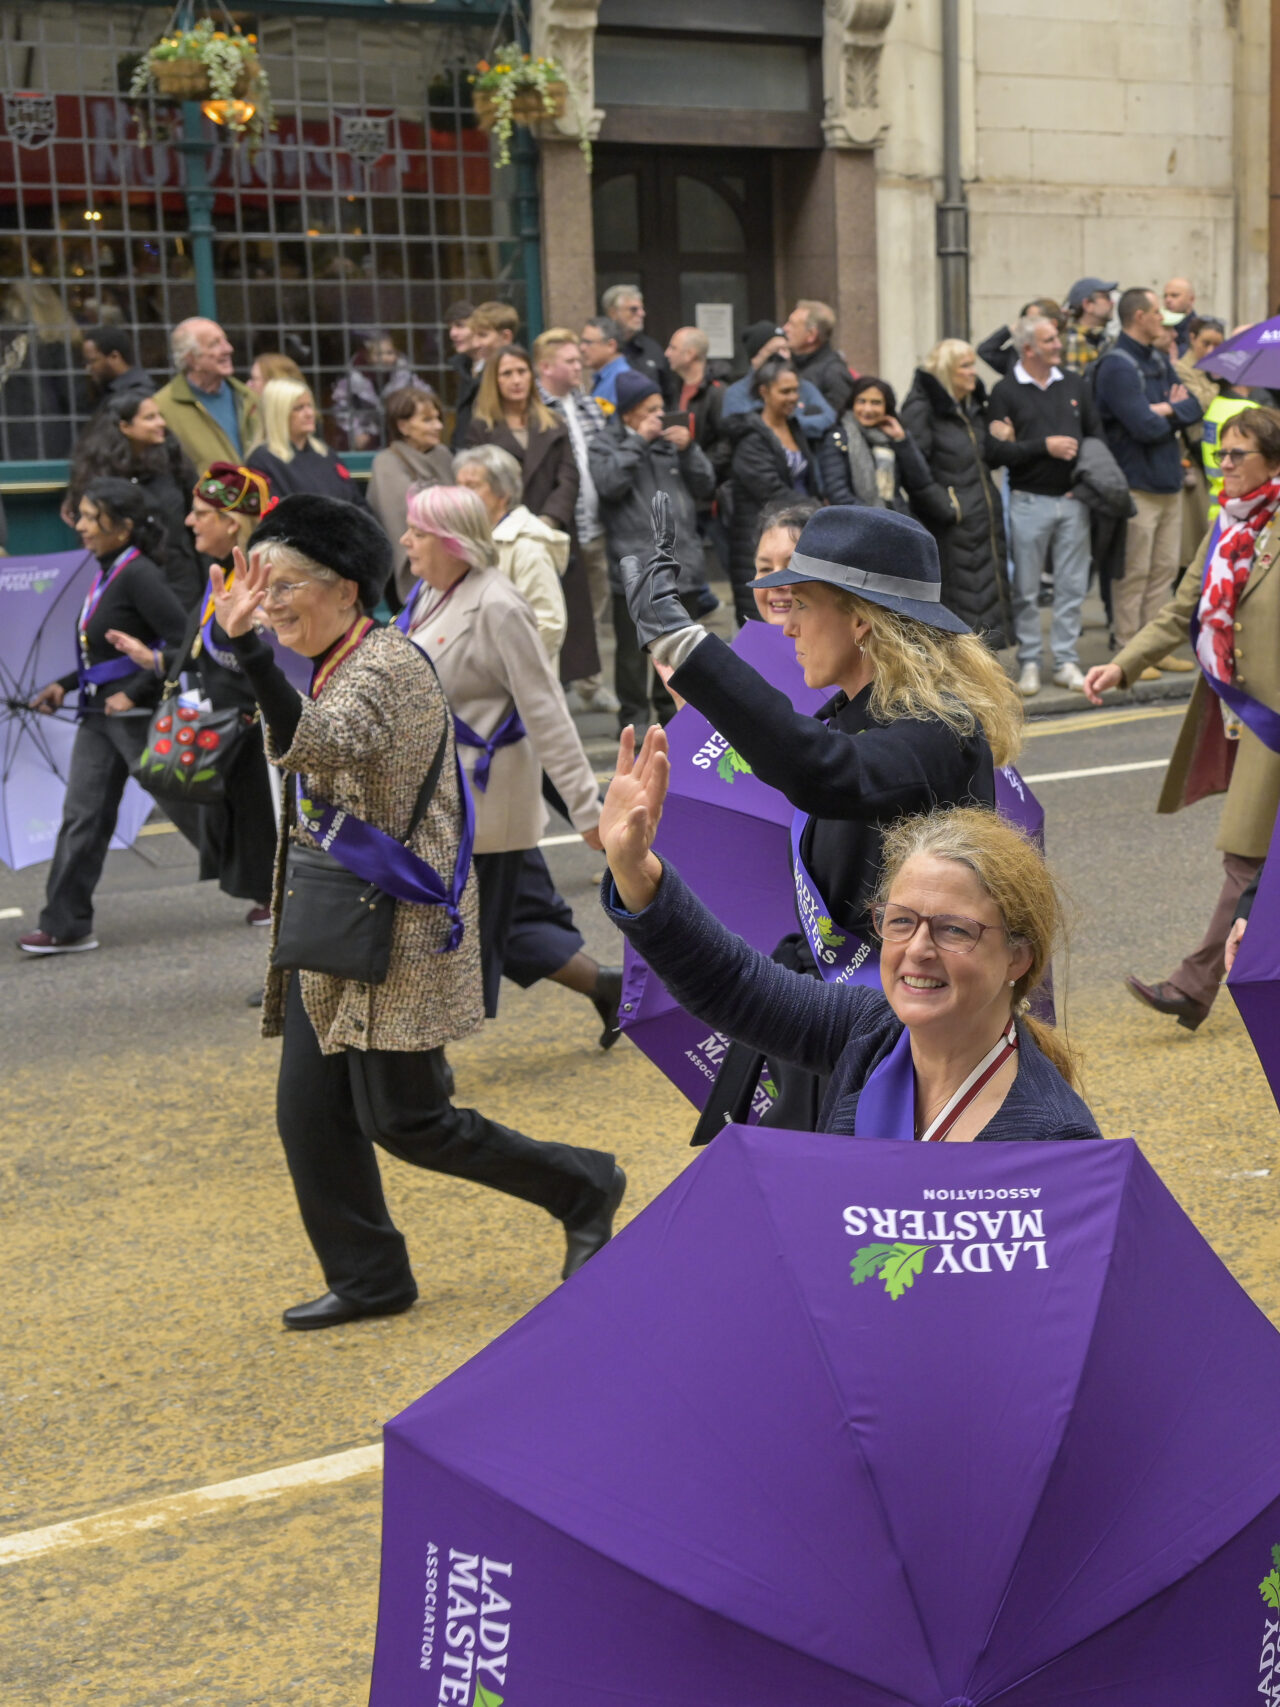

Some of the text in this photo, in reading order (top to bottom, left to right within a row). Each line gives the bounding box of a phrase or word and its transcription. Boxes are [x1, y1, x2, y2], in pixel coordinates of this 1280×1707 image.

[842, 1206, 1046, 1241] MASTERS
[923, 1188, 1041, 1200] ASSOCIATION
[932, 1241, 1049, 1273] LADY
[420, 1541, 438, 1671] ASSOCIATION
[437, 1548, 479, 1707] MASTE
[479, 1556, 513, 1686] LADY
[1257, 1618, 1280, 1707] ADY
